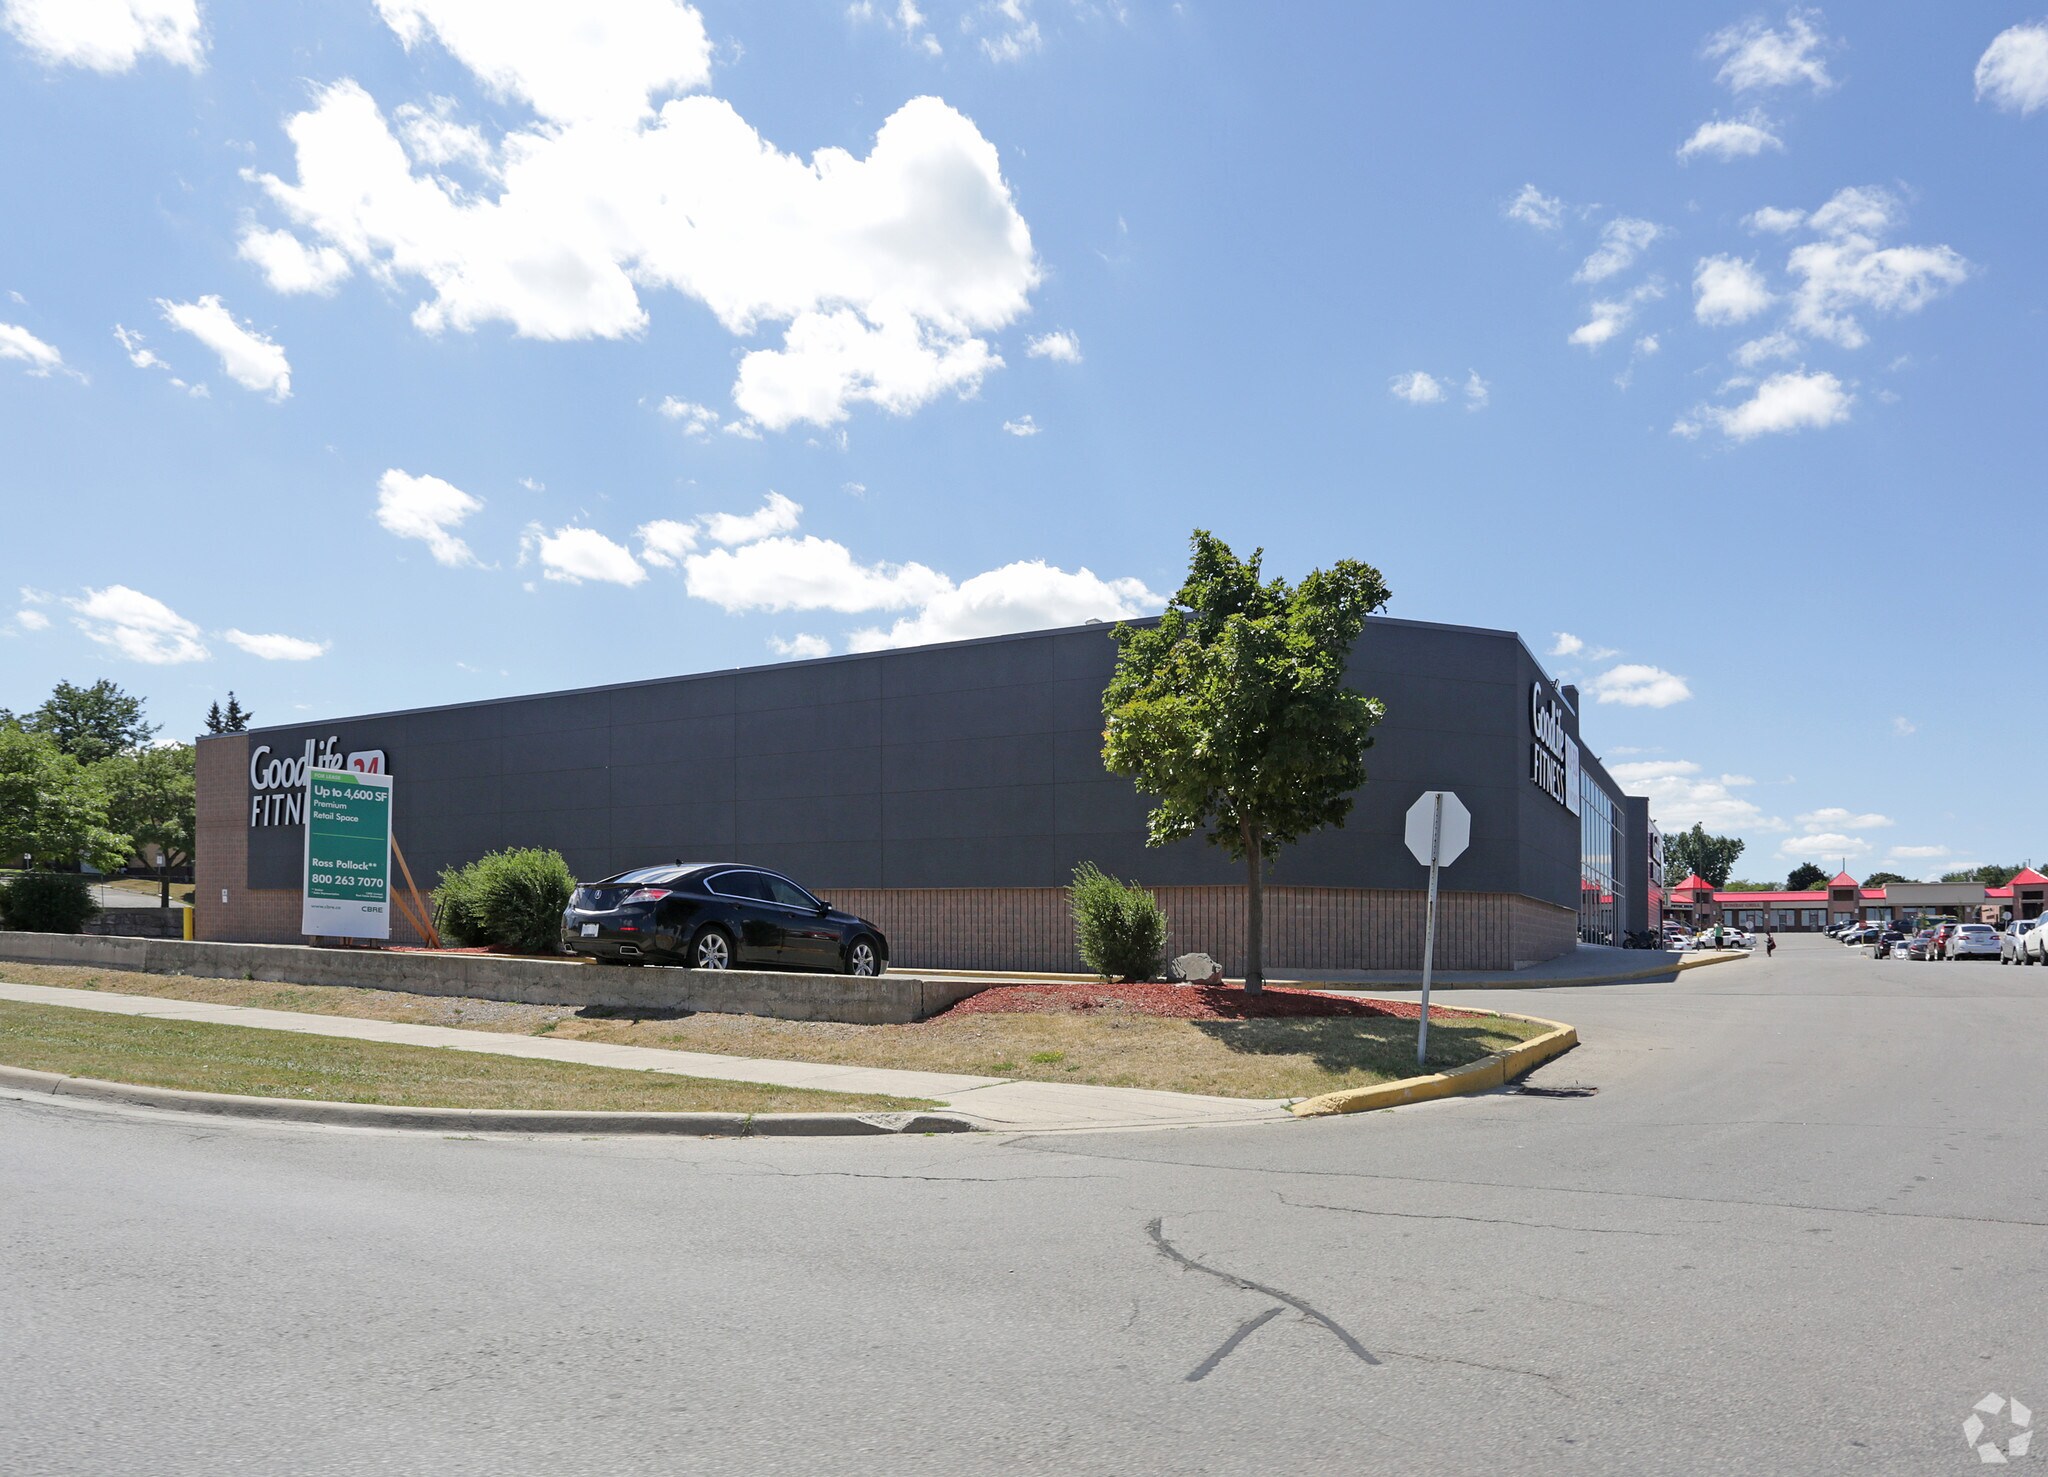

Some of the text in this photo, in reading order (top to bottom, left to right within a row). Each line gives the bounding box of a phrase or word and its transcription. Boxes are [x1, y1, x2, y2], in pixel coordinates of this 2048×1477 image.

[1533, 681, 1564, 762] GoodLife
[1534, 742, 1565, 805] FITNESS
[314, 785, 388, 802] Up to 4,600 SF
[251, 791, 307, 827] FITN
[313, 799, 347, 809] Premium
[313, 811, 359, 822] Retail Space
[312, 857, 333, 868] Ross
[312, 873, 384, 888] 800 263 7070
[361, 905, 383, 913] CBRE
